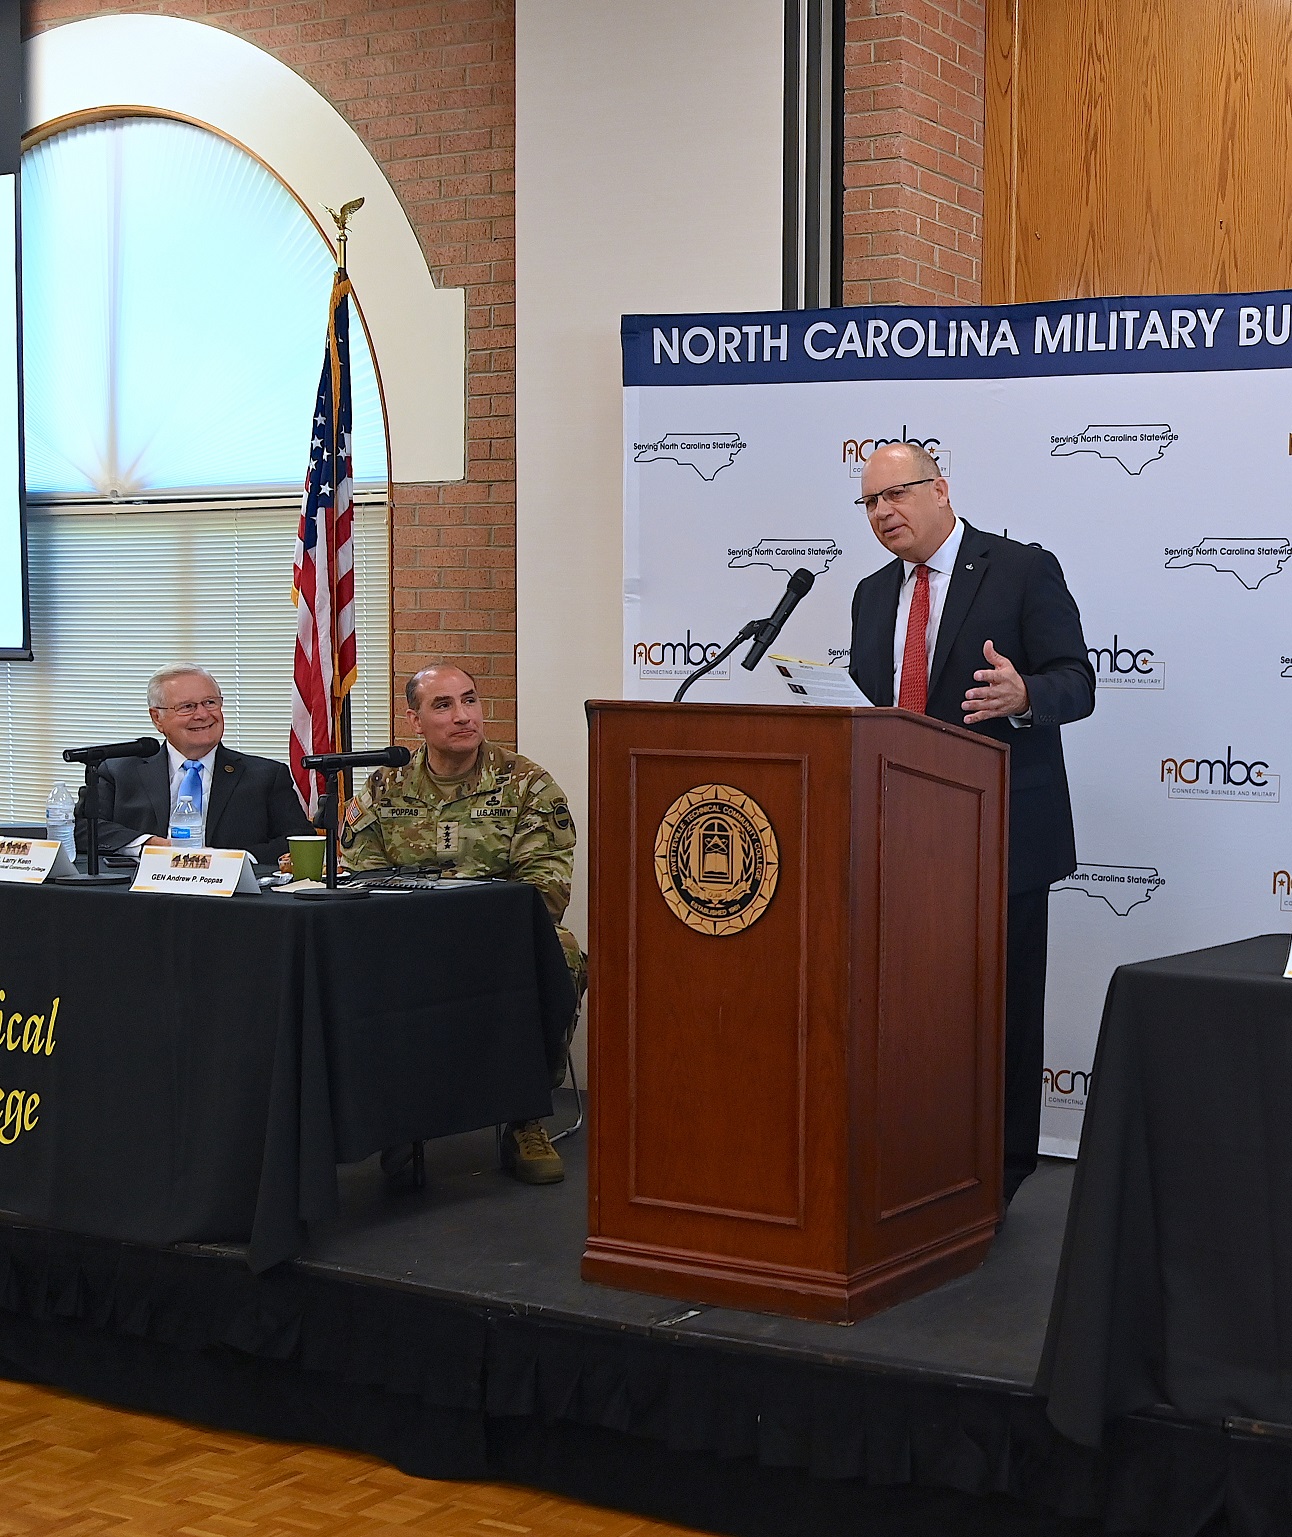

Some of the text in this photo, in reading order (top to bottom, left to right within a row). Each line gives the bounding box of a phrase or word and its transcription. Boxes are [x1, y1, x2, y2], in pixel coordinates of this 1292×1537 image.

[652, 323, 789, 364] NORTH
[803, 318, 1020, 361] CAROLINA
[1034, 308, 1225, 354] MILITARY
[1050, 435, 1078, 444] Serving
[1104, 434, 1137, 442] Carolina
[1139, 433, 1179, 441] Statewide
[633, 441, 747, 452] Serving North Carolina Statewide
[727, 548, 843, 557] Serving North Carolina Statewide
[1164, 547, 1193, 557] Serving
[1196, 547, 1217, 555] North
[1220, 547, 1255, 555] Carolina
[828, 648, 851, 656] Servin
[1087, 634, 1154, 674] mbc
[1161, 745, 1269, 787] ncmbc
[391, 808, 419, 816] POPPAS
[722, 806, 758, 839] COMMUNITY
[754, 842, 762, 880] COLLEGE
[151, 873, 166, 881] GEN
[166, 874, 191, 882] Andrew
[199, 876, 223, 885] Poppas
[1068, 873, 1166, 885] North Carolina Statewide
